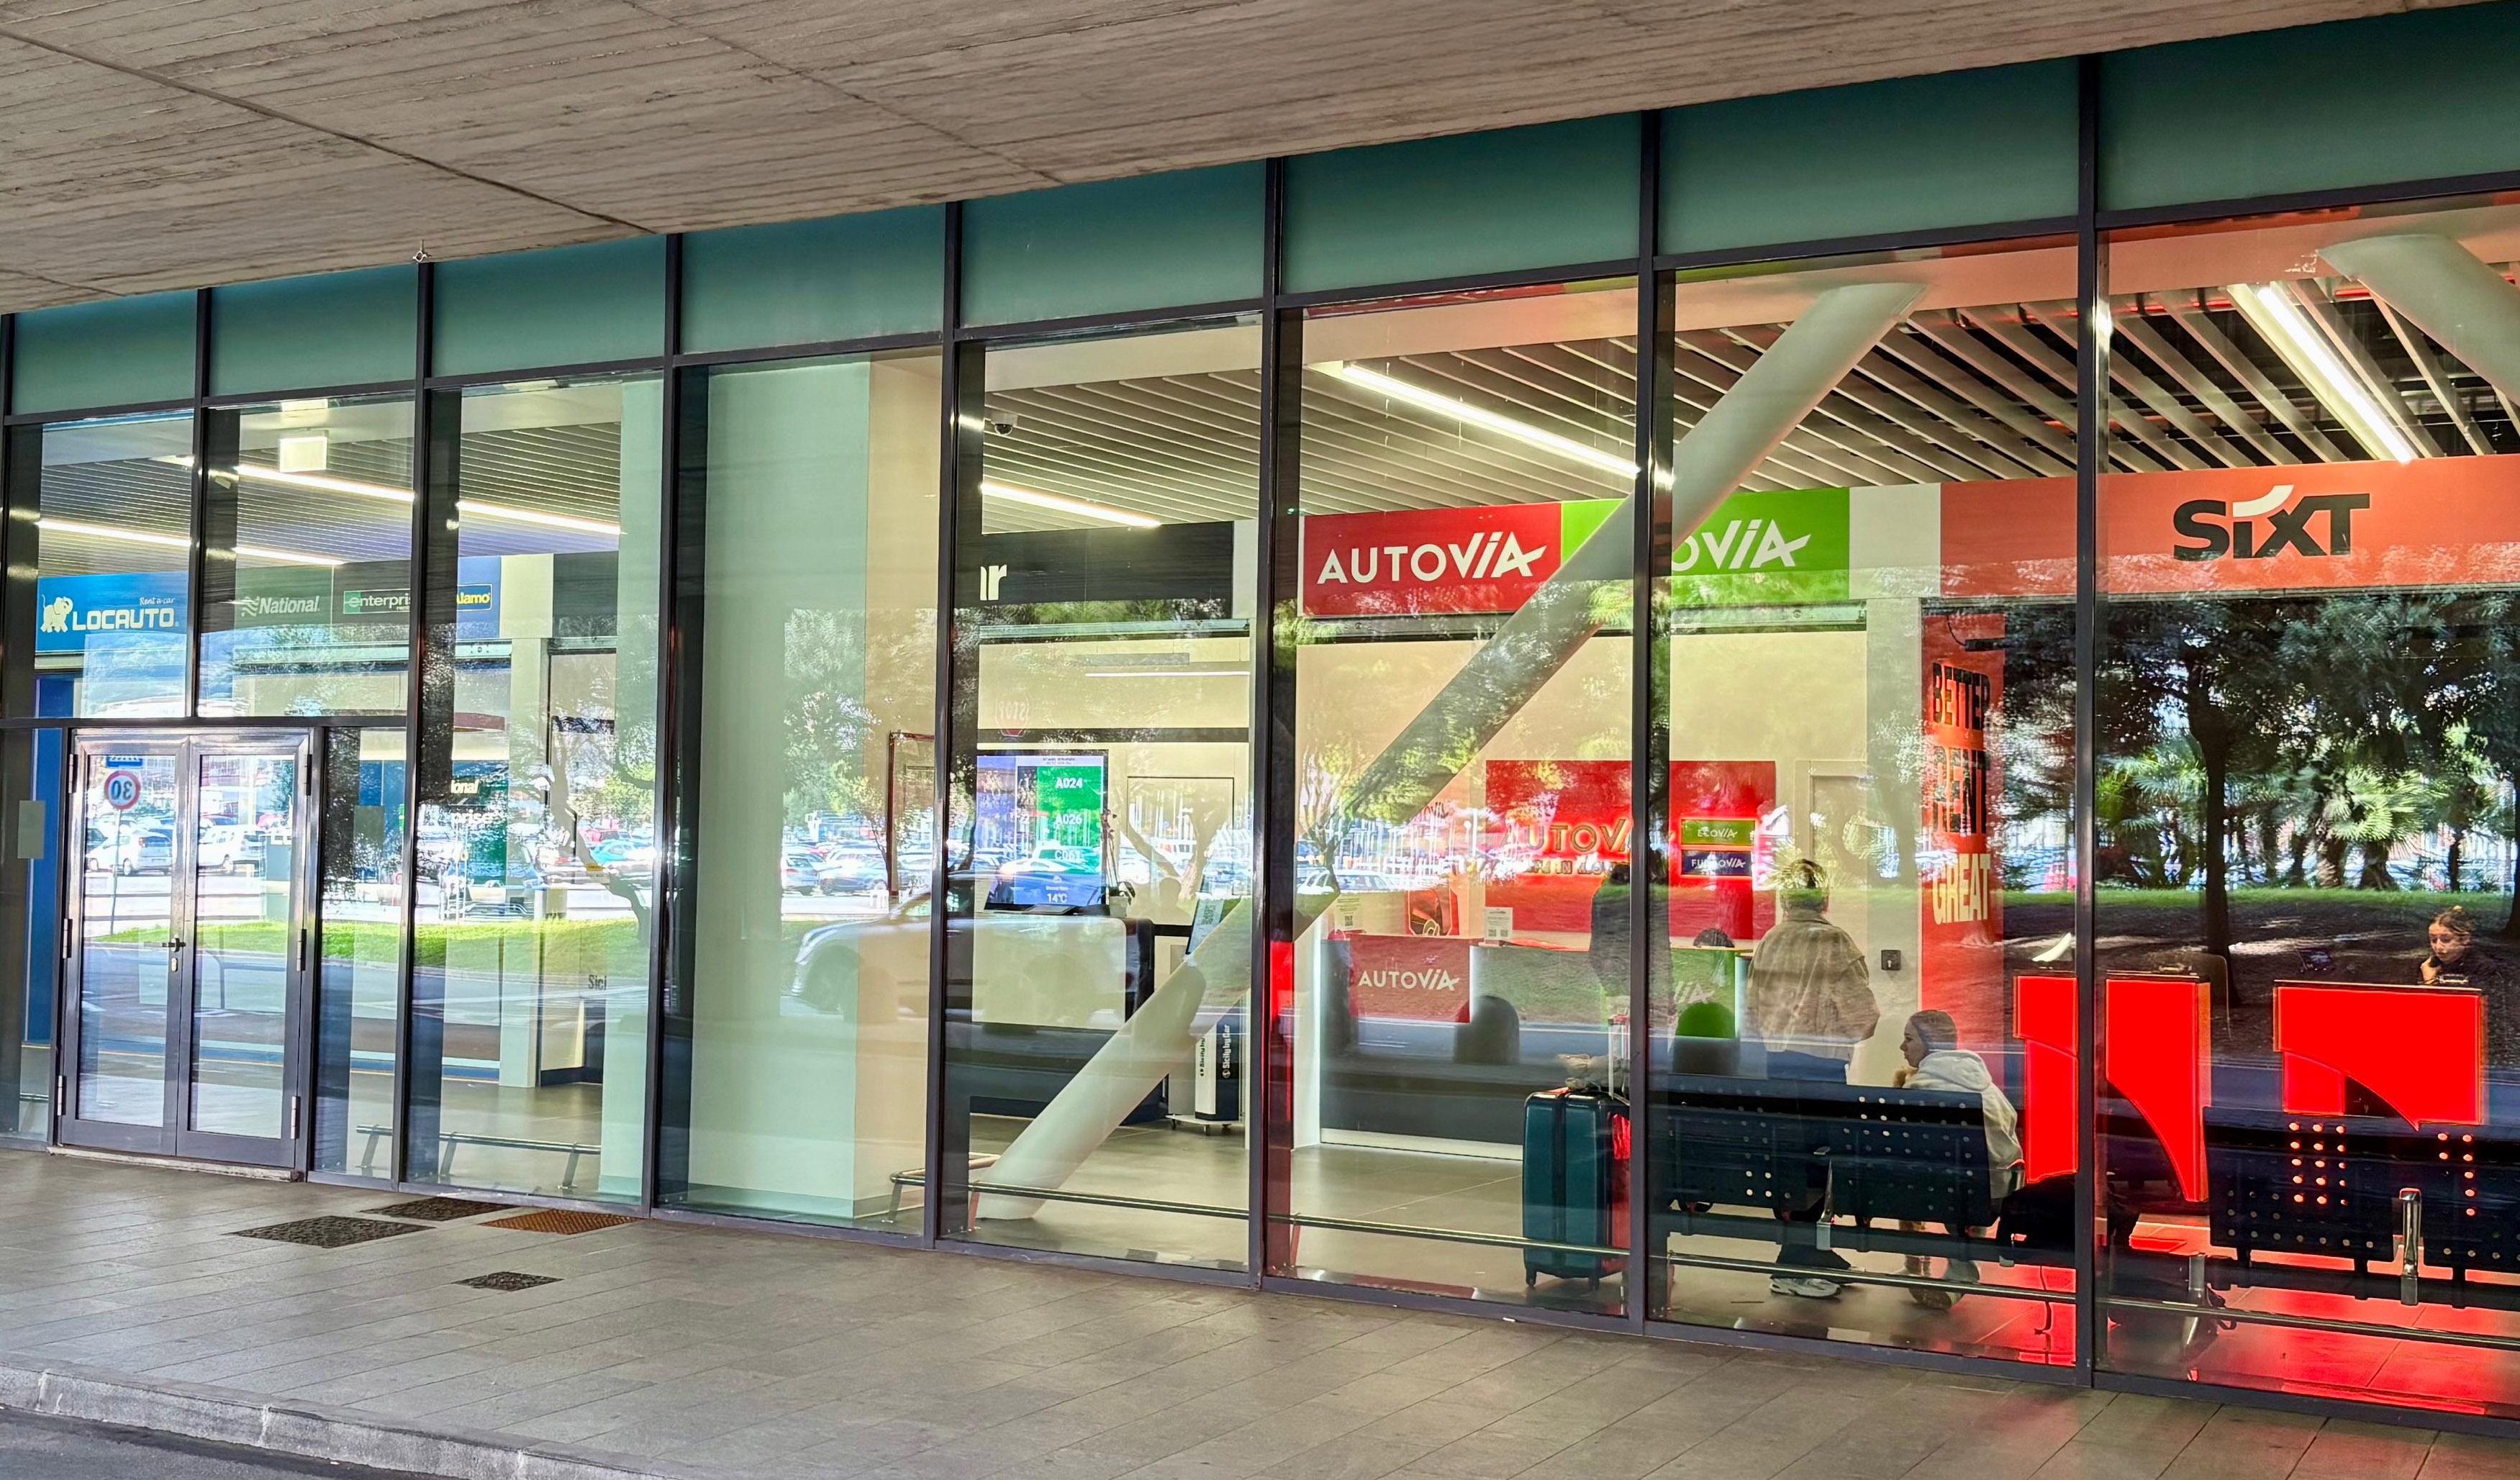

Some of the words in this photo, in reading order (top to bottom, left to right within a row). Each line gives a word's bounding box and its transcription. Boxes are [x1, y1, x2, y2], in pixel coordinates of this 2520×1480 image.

[1672, 519, 1812, 571] OVIA
[258, 595, 319, 614] National
[348, 592, 411, 609] enterpri
[73, 608, 174, 631] LOCAUTO
[1933, 663, 1990, 731] BETTER
[450, 779, 479, 794] ional
[1055, 777, 1083, 789] A024
[1933, 745, 1990, 835] RENT
[1501, 818, 1627, 853] AUTOV
[1691, 858, 1746, 868] FUOVIA
[1932, 853, 1990, 925] GREAT
[1223, 1049, 1231, 1068] Sicily
